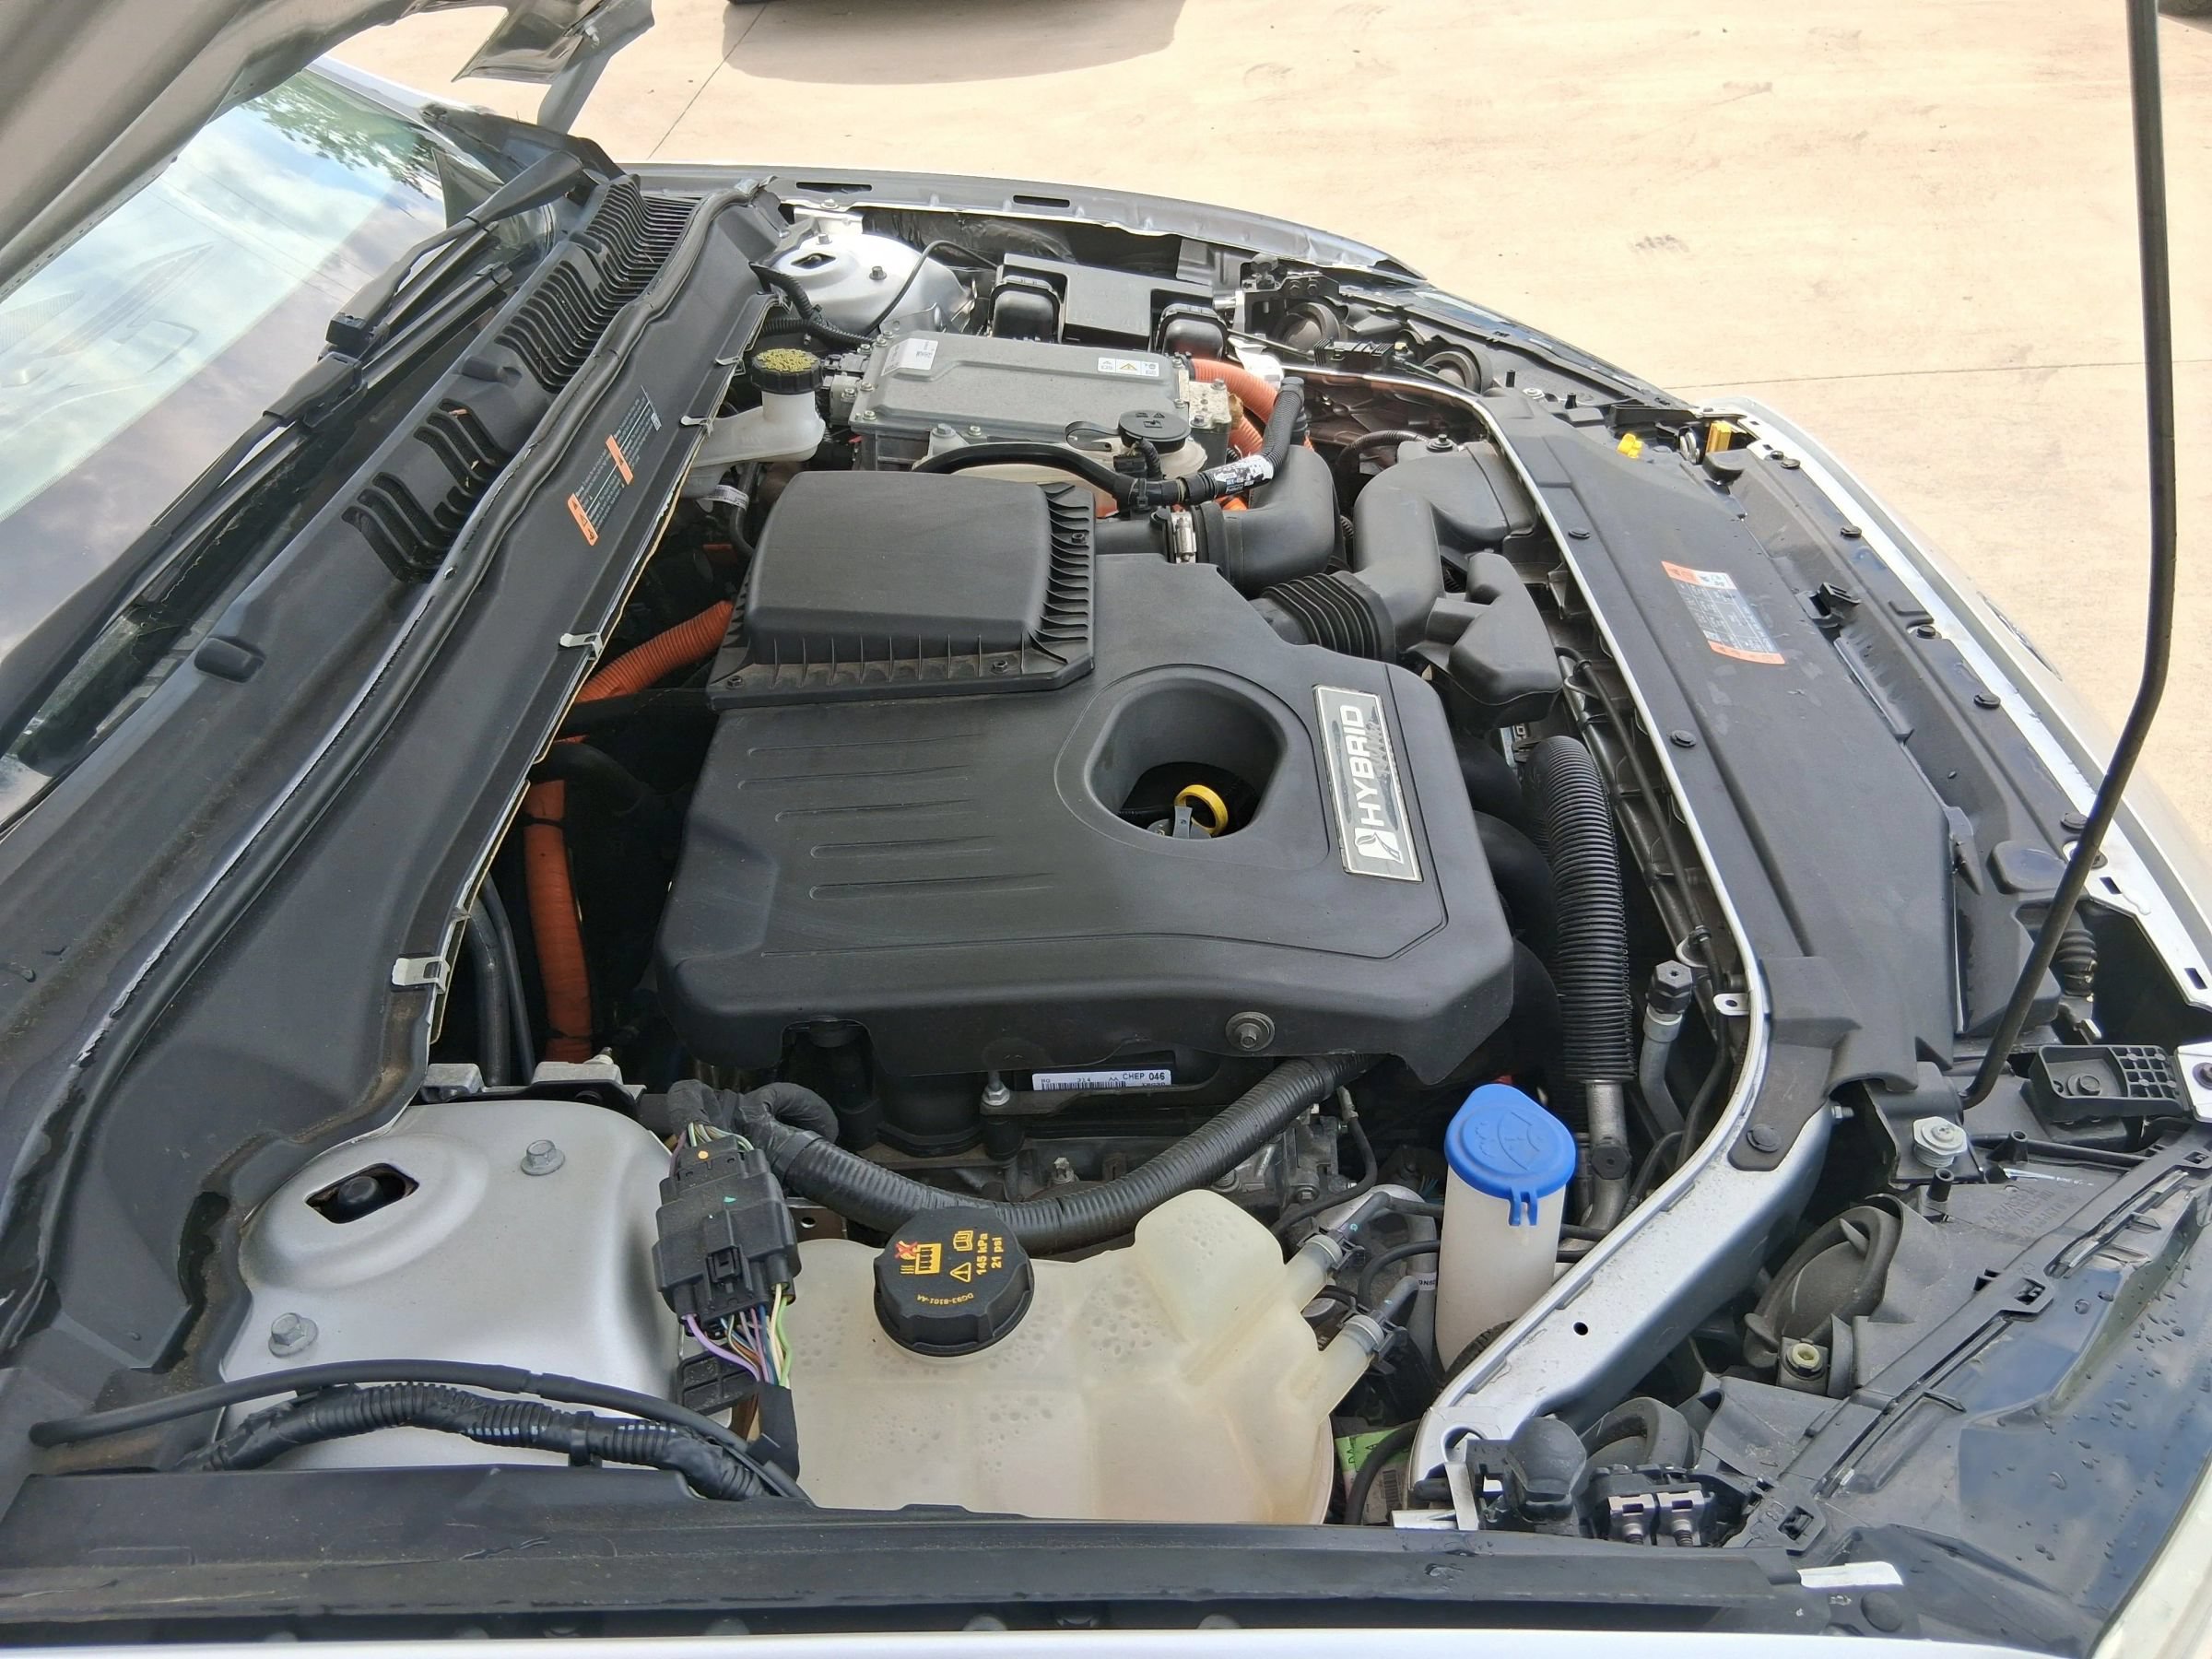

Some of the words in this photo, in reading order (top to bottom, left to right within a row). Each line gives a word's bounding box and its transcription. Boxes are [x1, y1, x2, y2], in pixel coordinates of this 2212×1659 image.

[1339, 704, 1385, 827] HYBRID
[1123, 1072, 1145, 1080] CHEP
[1148, 1072, 1165, 1081] 046
[977, 1233, 989, 1253] kPa
[992, 1237, 1005, 1253] psi
[976, 1255, 988, 1276] 145
[991, 1255, 1003, 1269] 21
